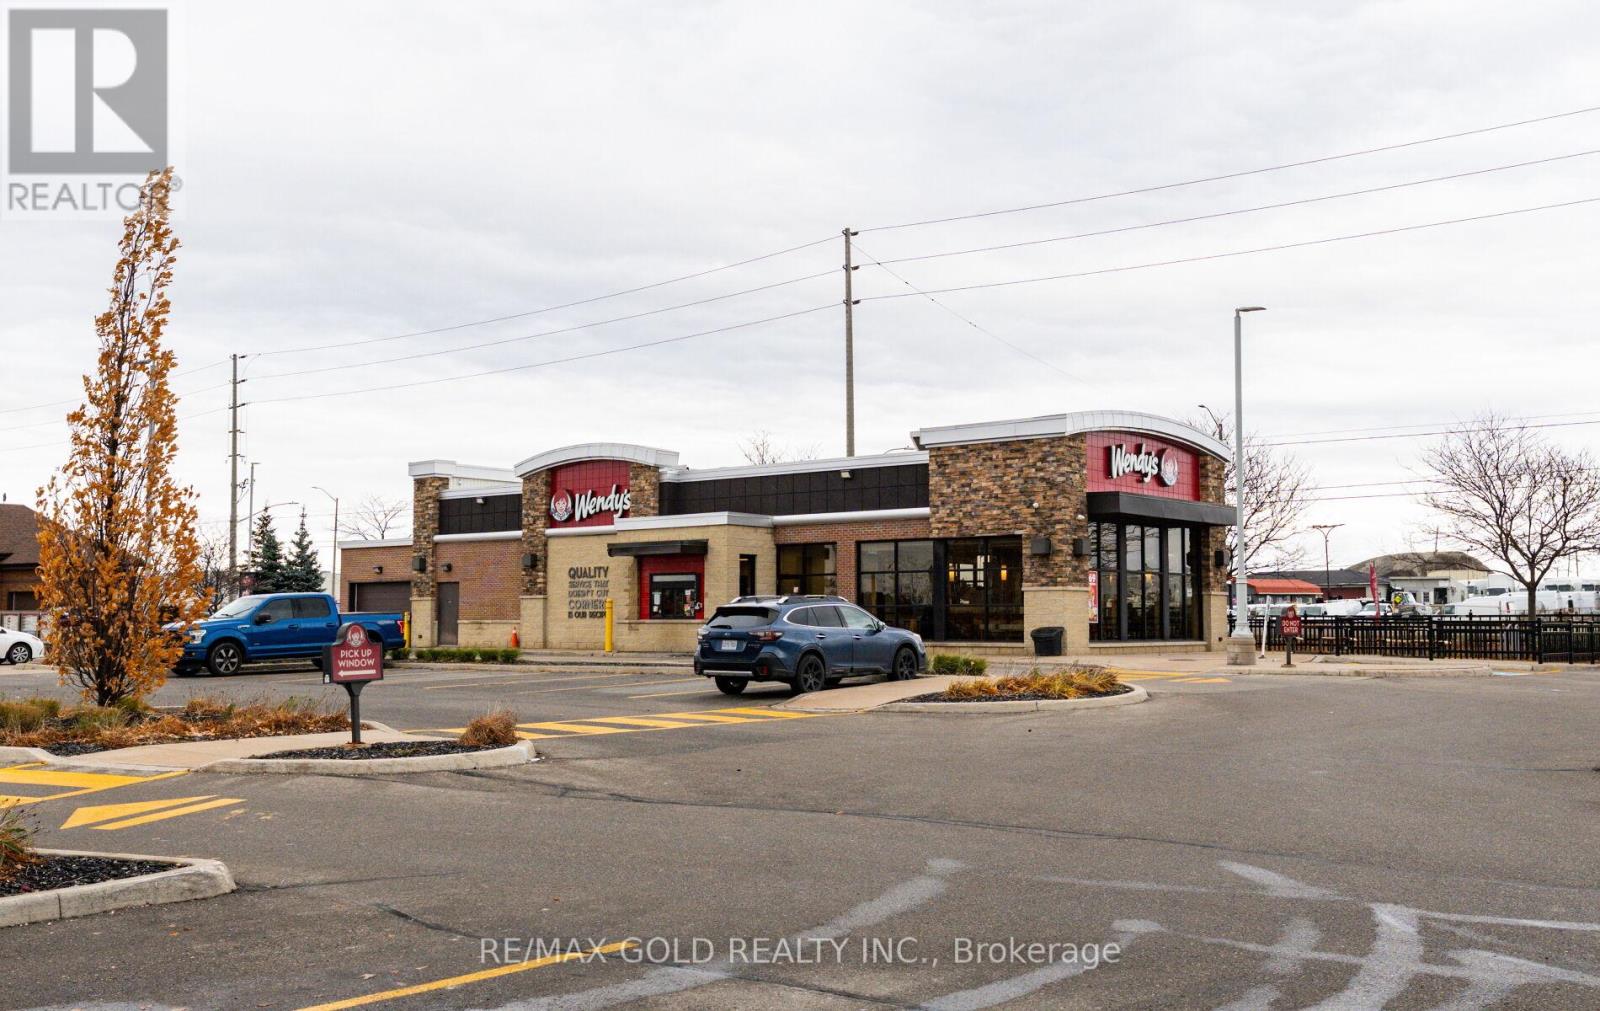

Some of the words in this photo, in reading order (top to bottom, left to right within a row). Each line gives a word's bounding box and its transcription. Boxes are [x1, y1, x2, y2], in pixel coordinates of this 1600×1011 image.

[1111, 443, 1159, 483] Wendy's
[574, 484, 631, 522] Wendy's
[568, 566, 609, 580] QUALITY
[340, 650, 360, 658] PICK
[361, 649, 372, 658] UP
[338, 658, 375, 667] WINDOW
